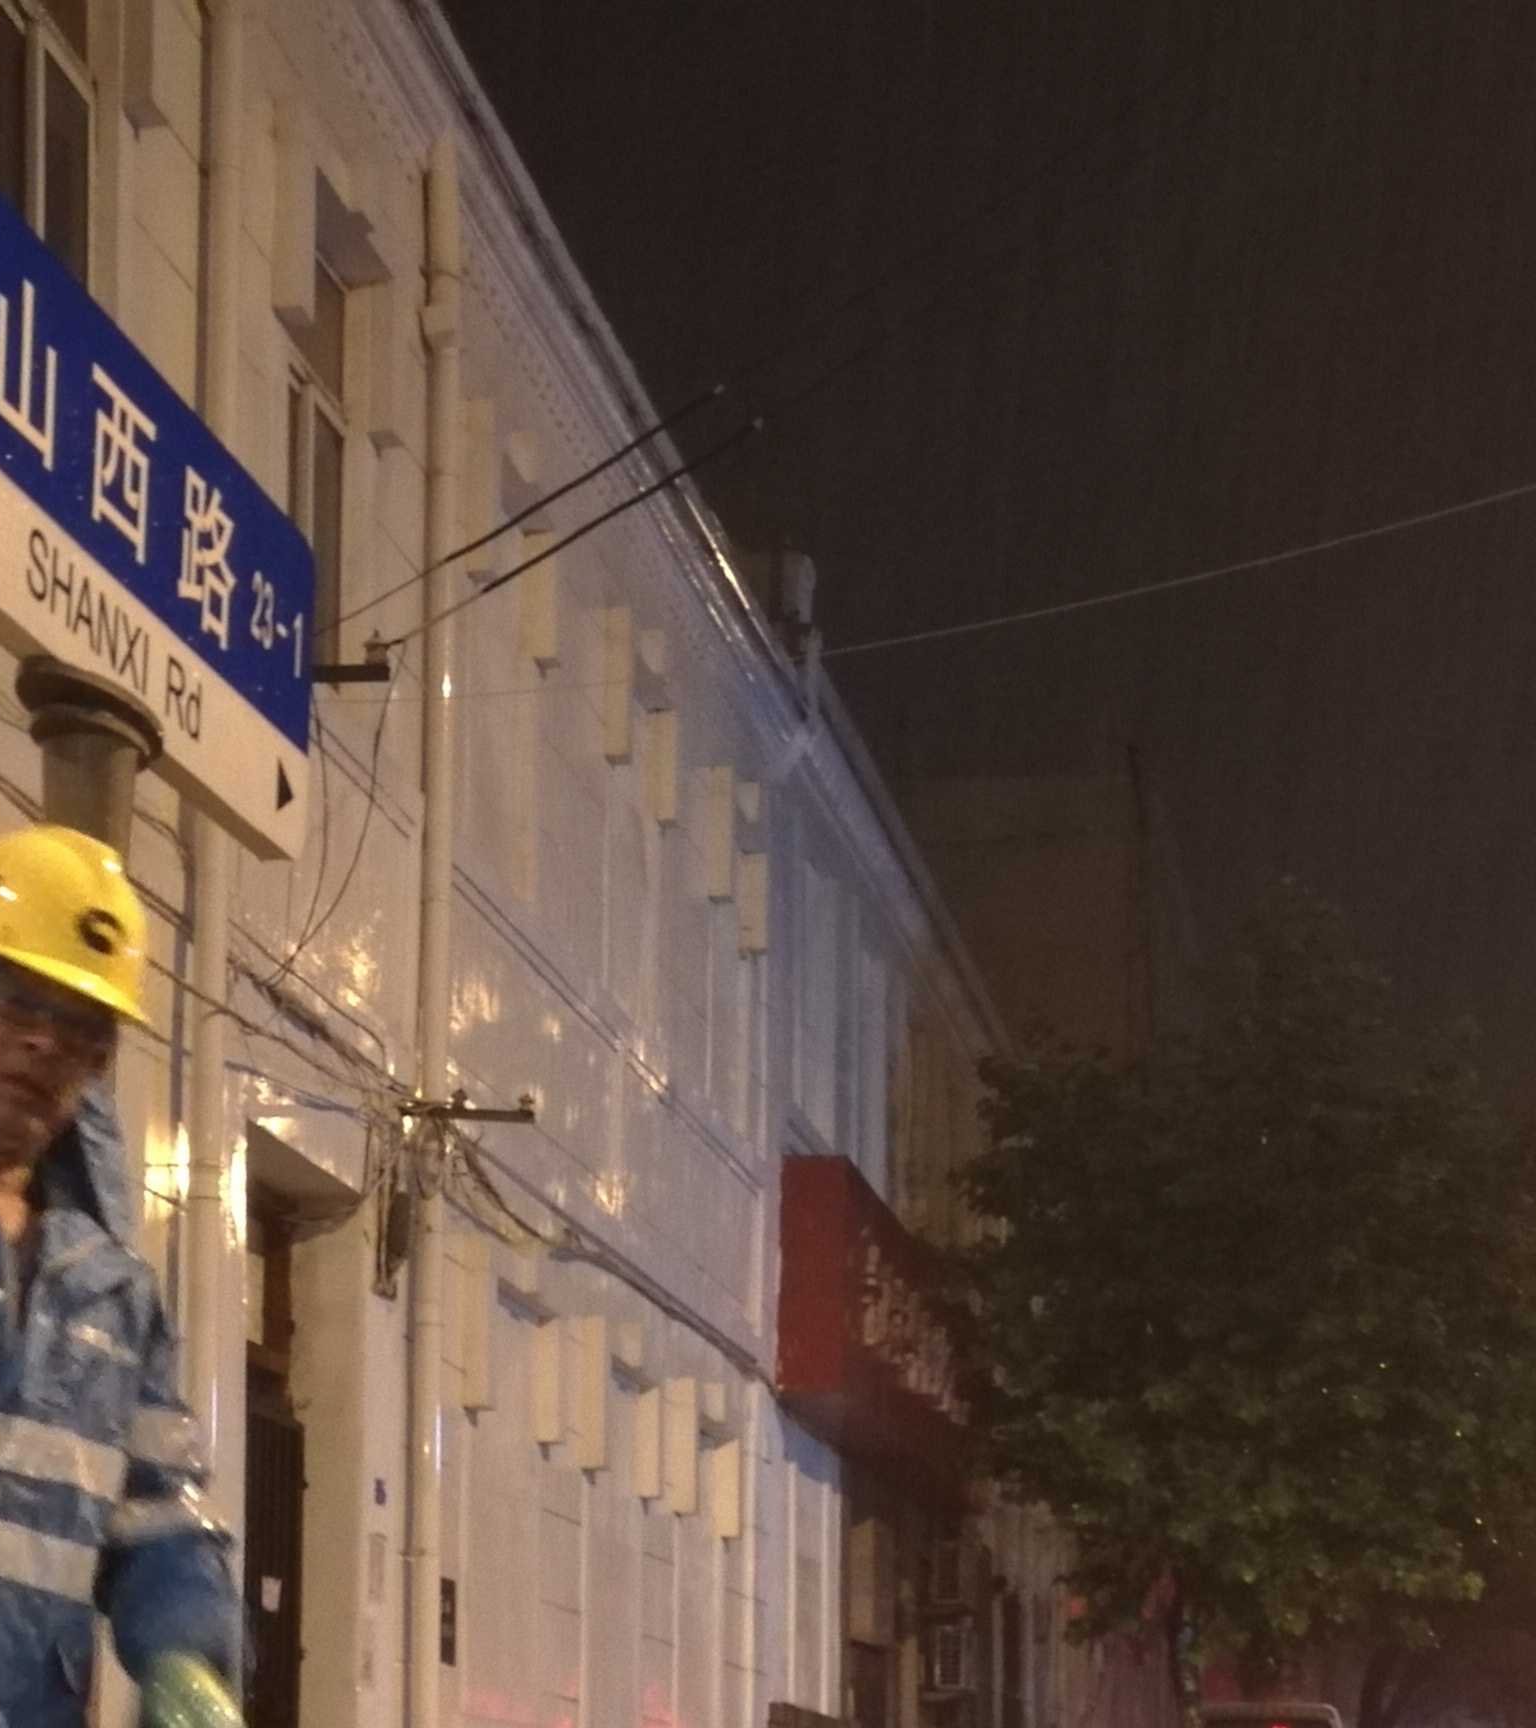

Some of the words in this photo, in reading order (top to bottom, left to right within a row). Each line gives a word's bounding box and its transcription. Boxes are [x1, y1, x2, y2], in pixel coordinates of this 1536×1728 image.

[26, 529, 150, 695] SHANXI
[166, 655, 203, 742] Rd
[249, 571, 302, 679] 23-1
